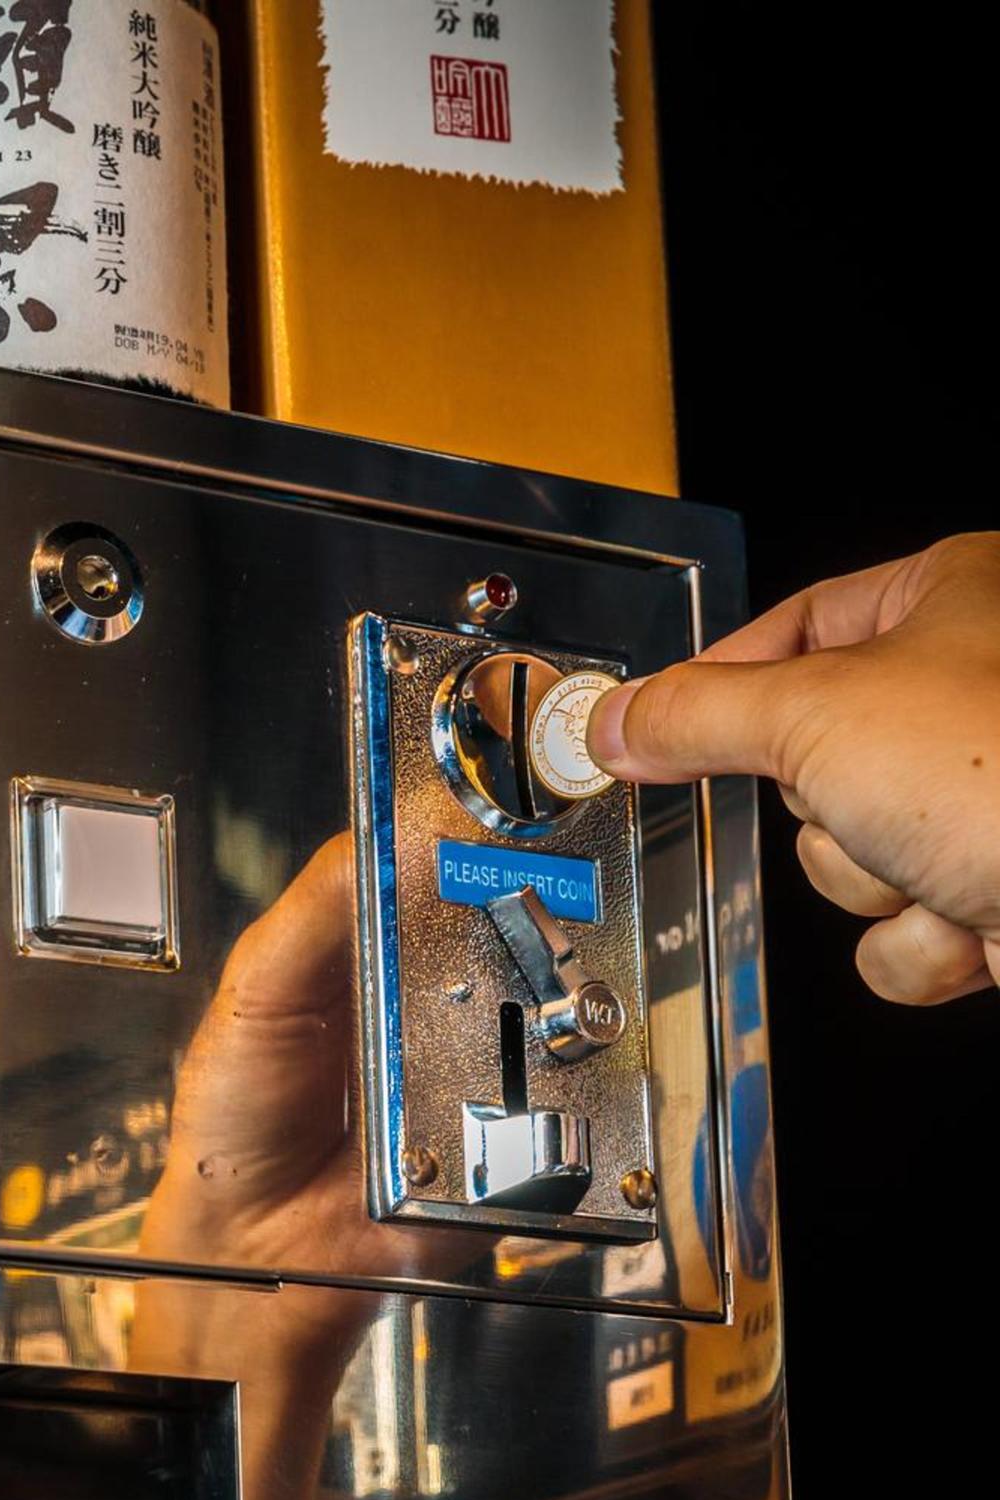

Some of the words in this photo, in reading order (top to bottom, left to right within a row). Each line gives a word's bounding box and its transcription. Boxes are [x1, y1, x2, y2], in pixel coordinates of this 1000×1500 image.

[15, 149, 33, 162] 23
[92, 122, 128, 295] 磨き二割三分
[444, 860, 499, 888] PLEASE
[557, 877, 594, 902] COIN
